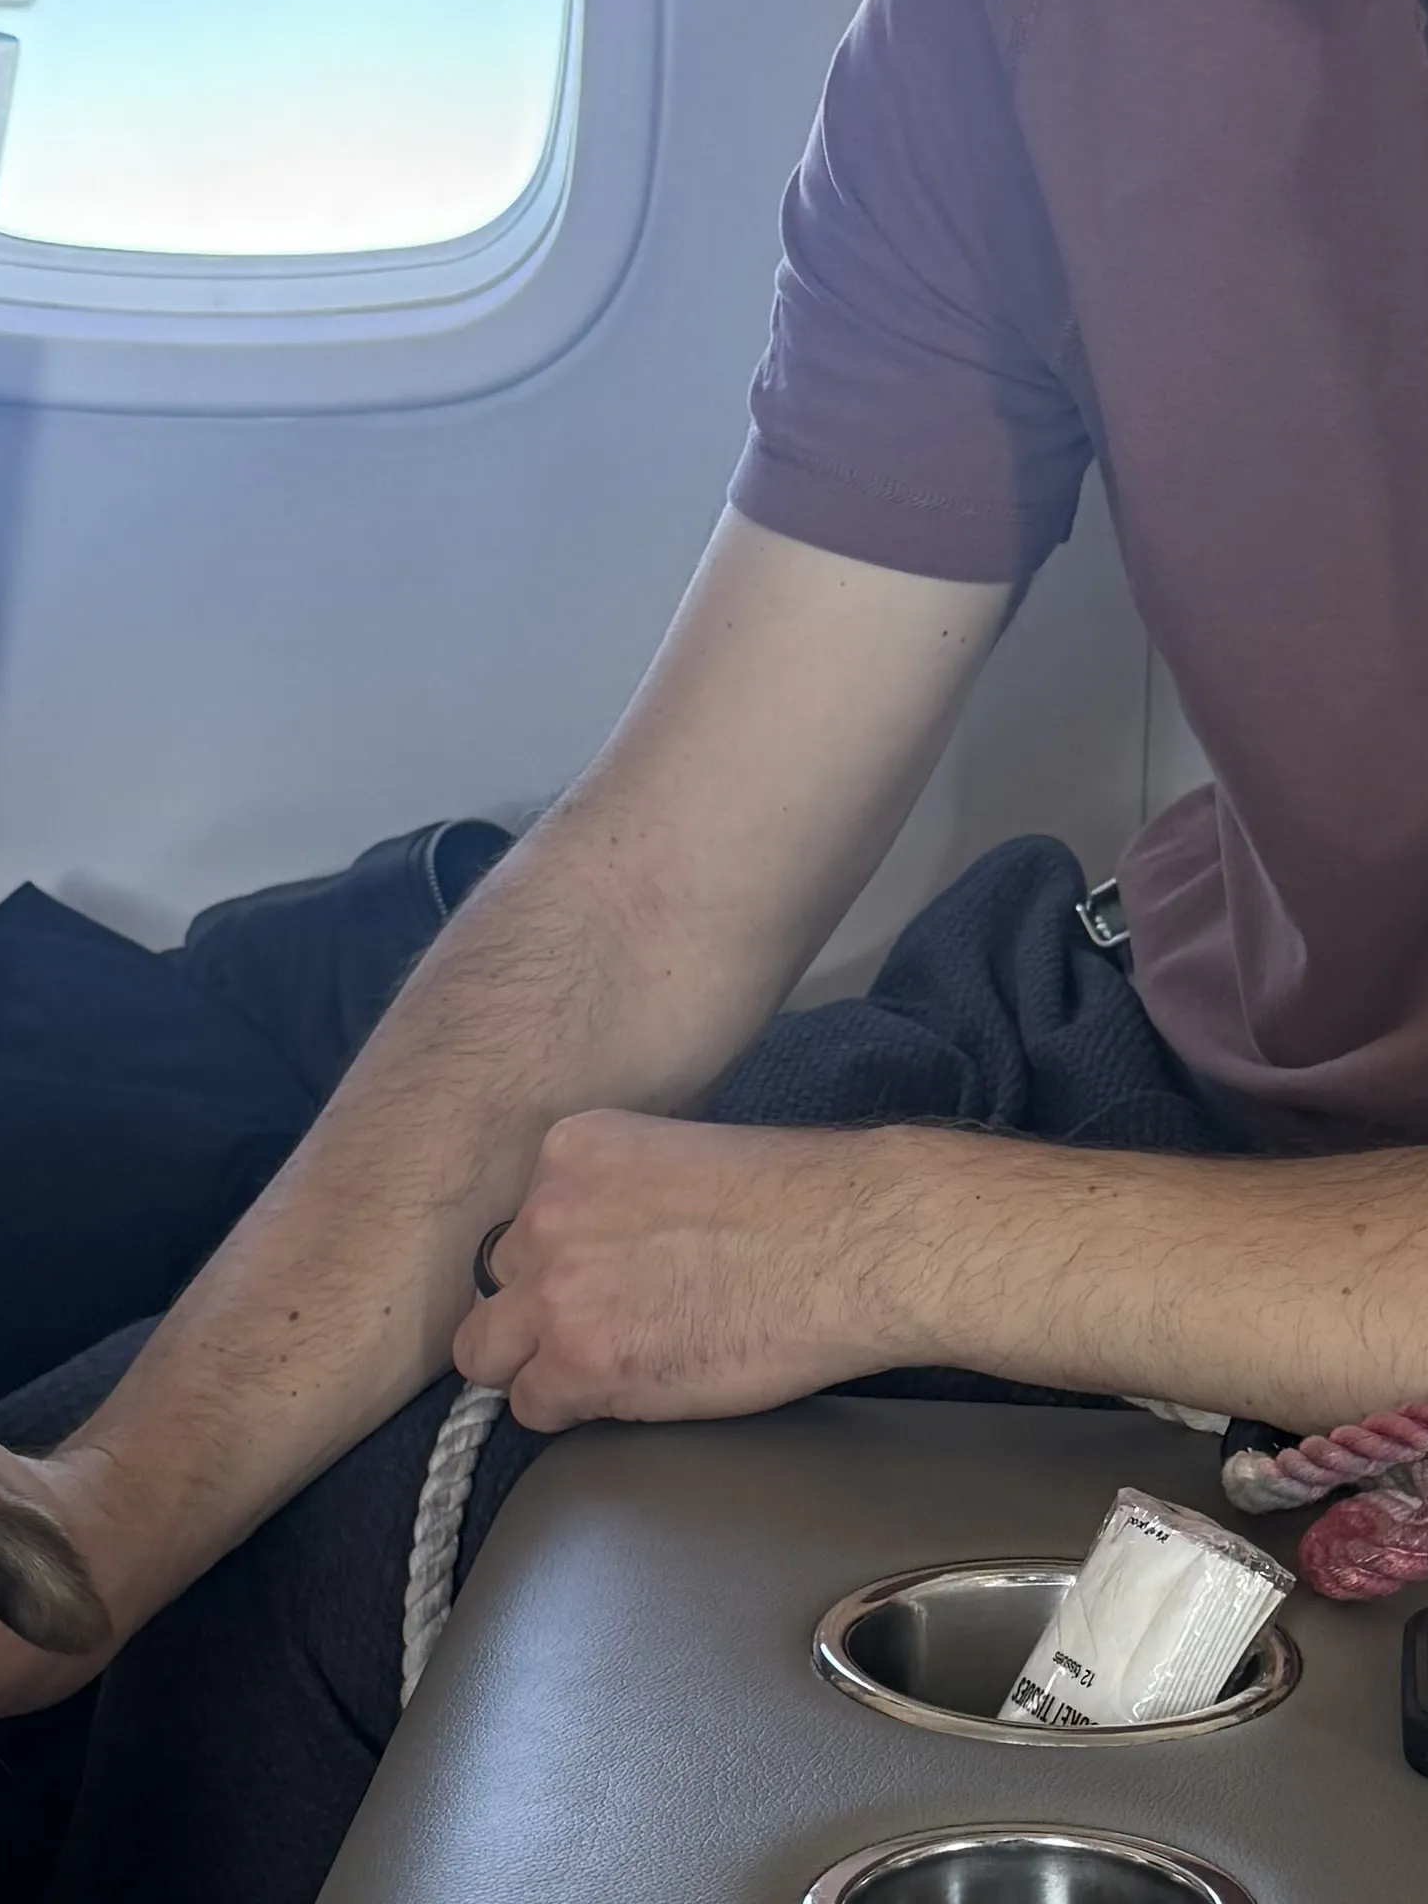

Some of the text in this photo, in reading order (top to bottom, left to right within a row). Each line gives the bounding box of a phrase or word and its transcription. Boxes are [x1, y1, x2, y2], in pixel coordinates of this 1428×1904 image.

[1052, 1651, 1095, 1688] 12 tissues
[1011, 1677, 1056, 1723] TISSUES
